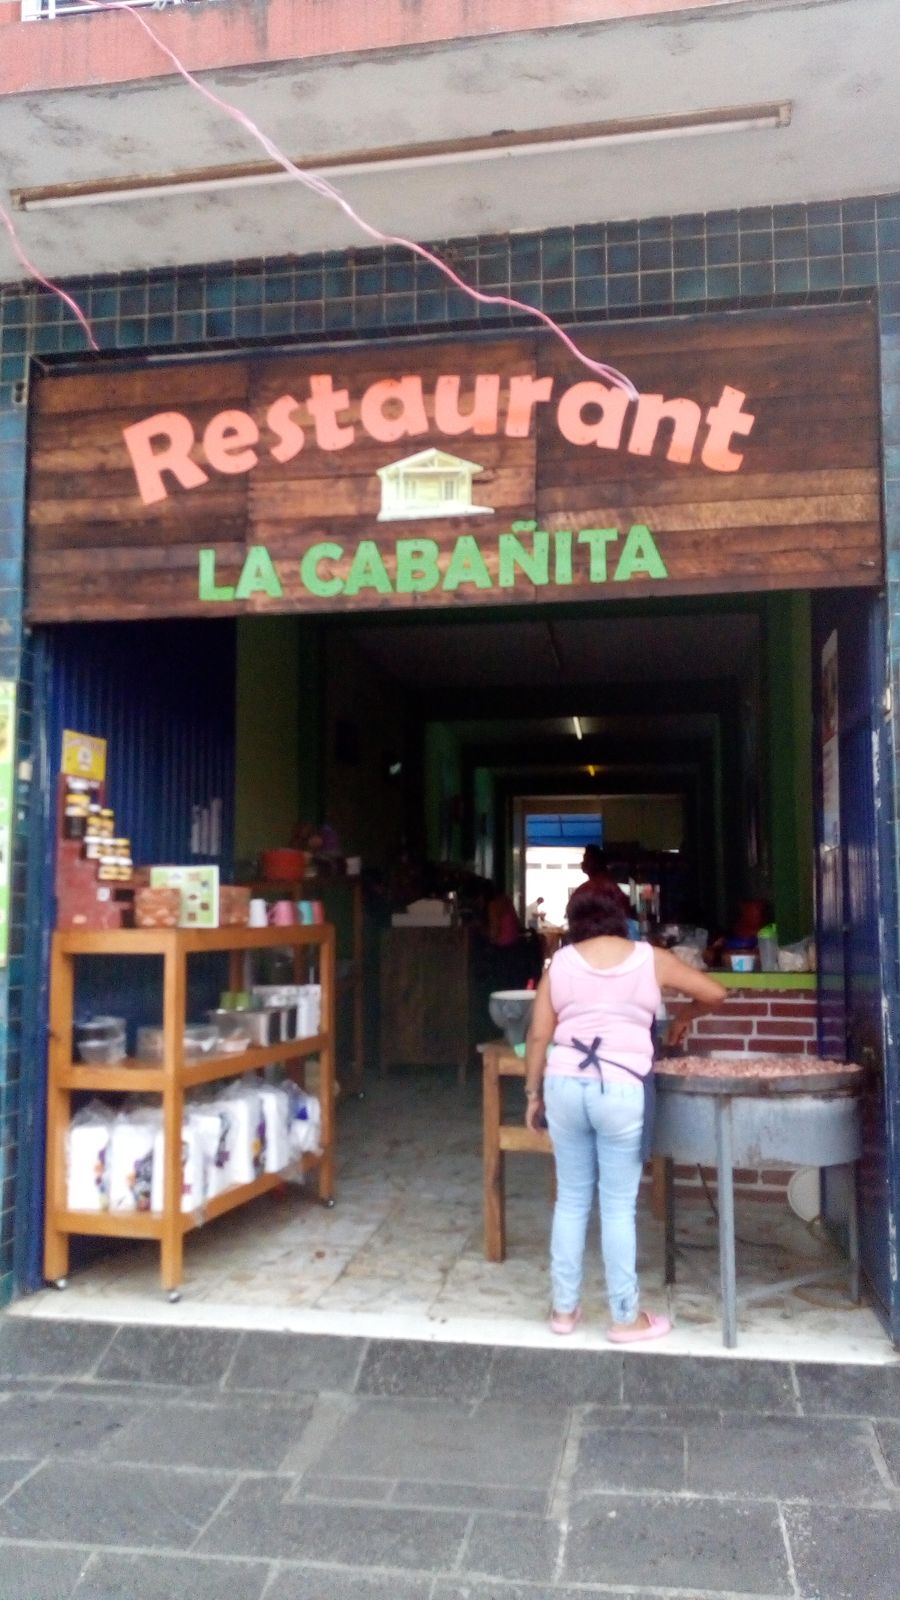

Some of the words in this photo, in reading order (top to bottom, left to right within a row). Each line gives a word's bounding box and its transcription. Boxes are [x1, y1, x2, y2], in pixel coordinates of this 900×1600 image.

[122, 373, 755, 506] Restaurant
[198, 545, 283, 603] LA
[299, 520, 668, 598] CABAÑITA
